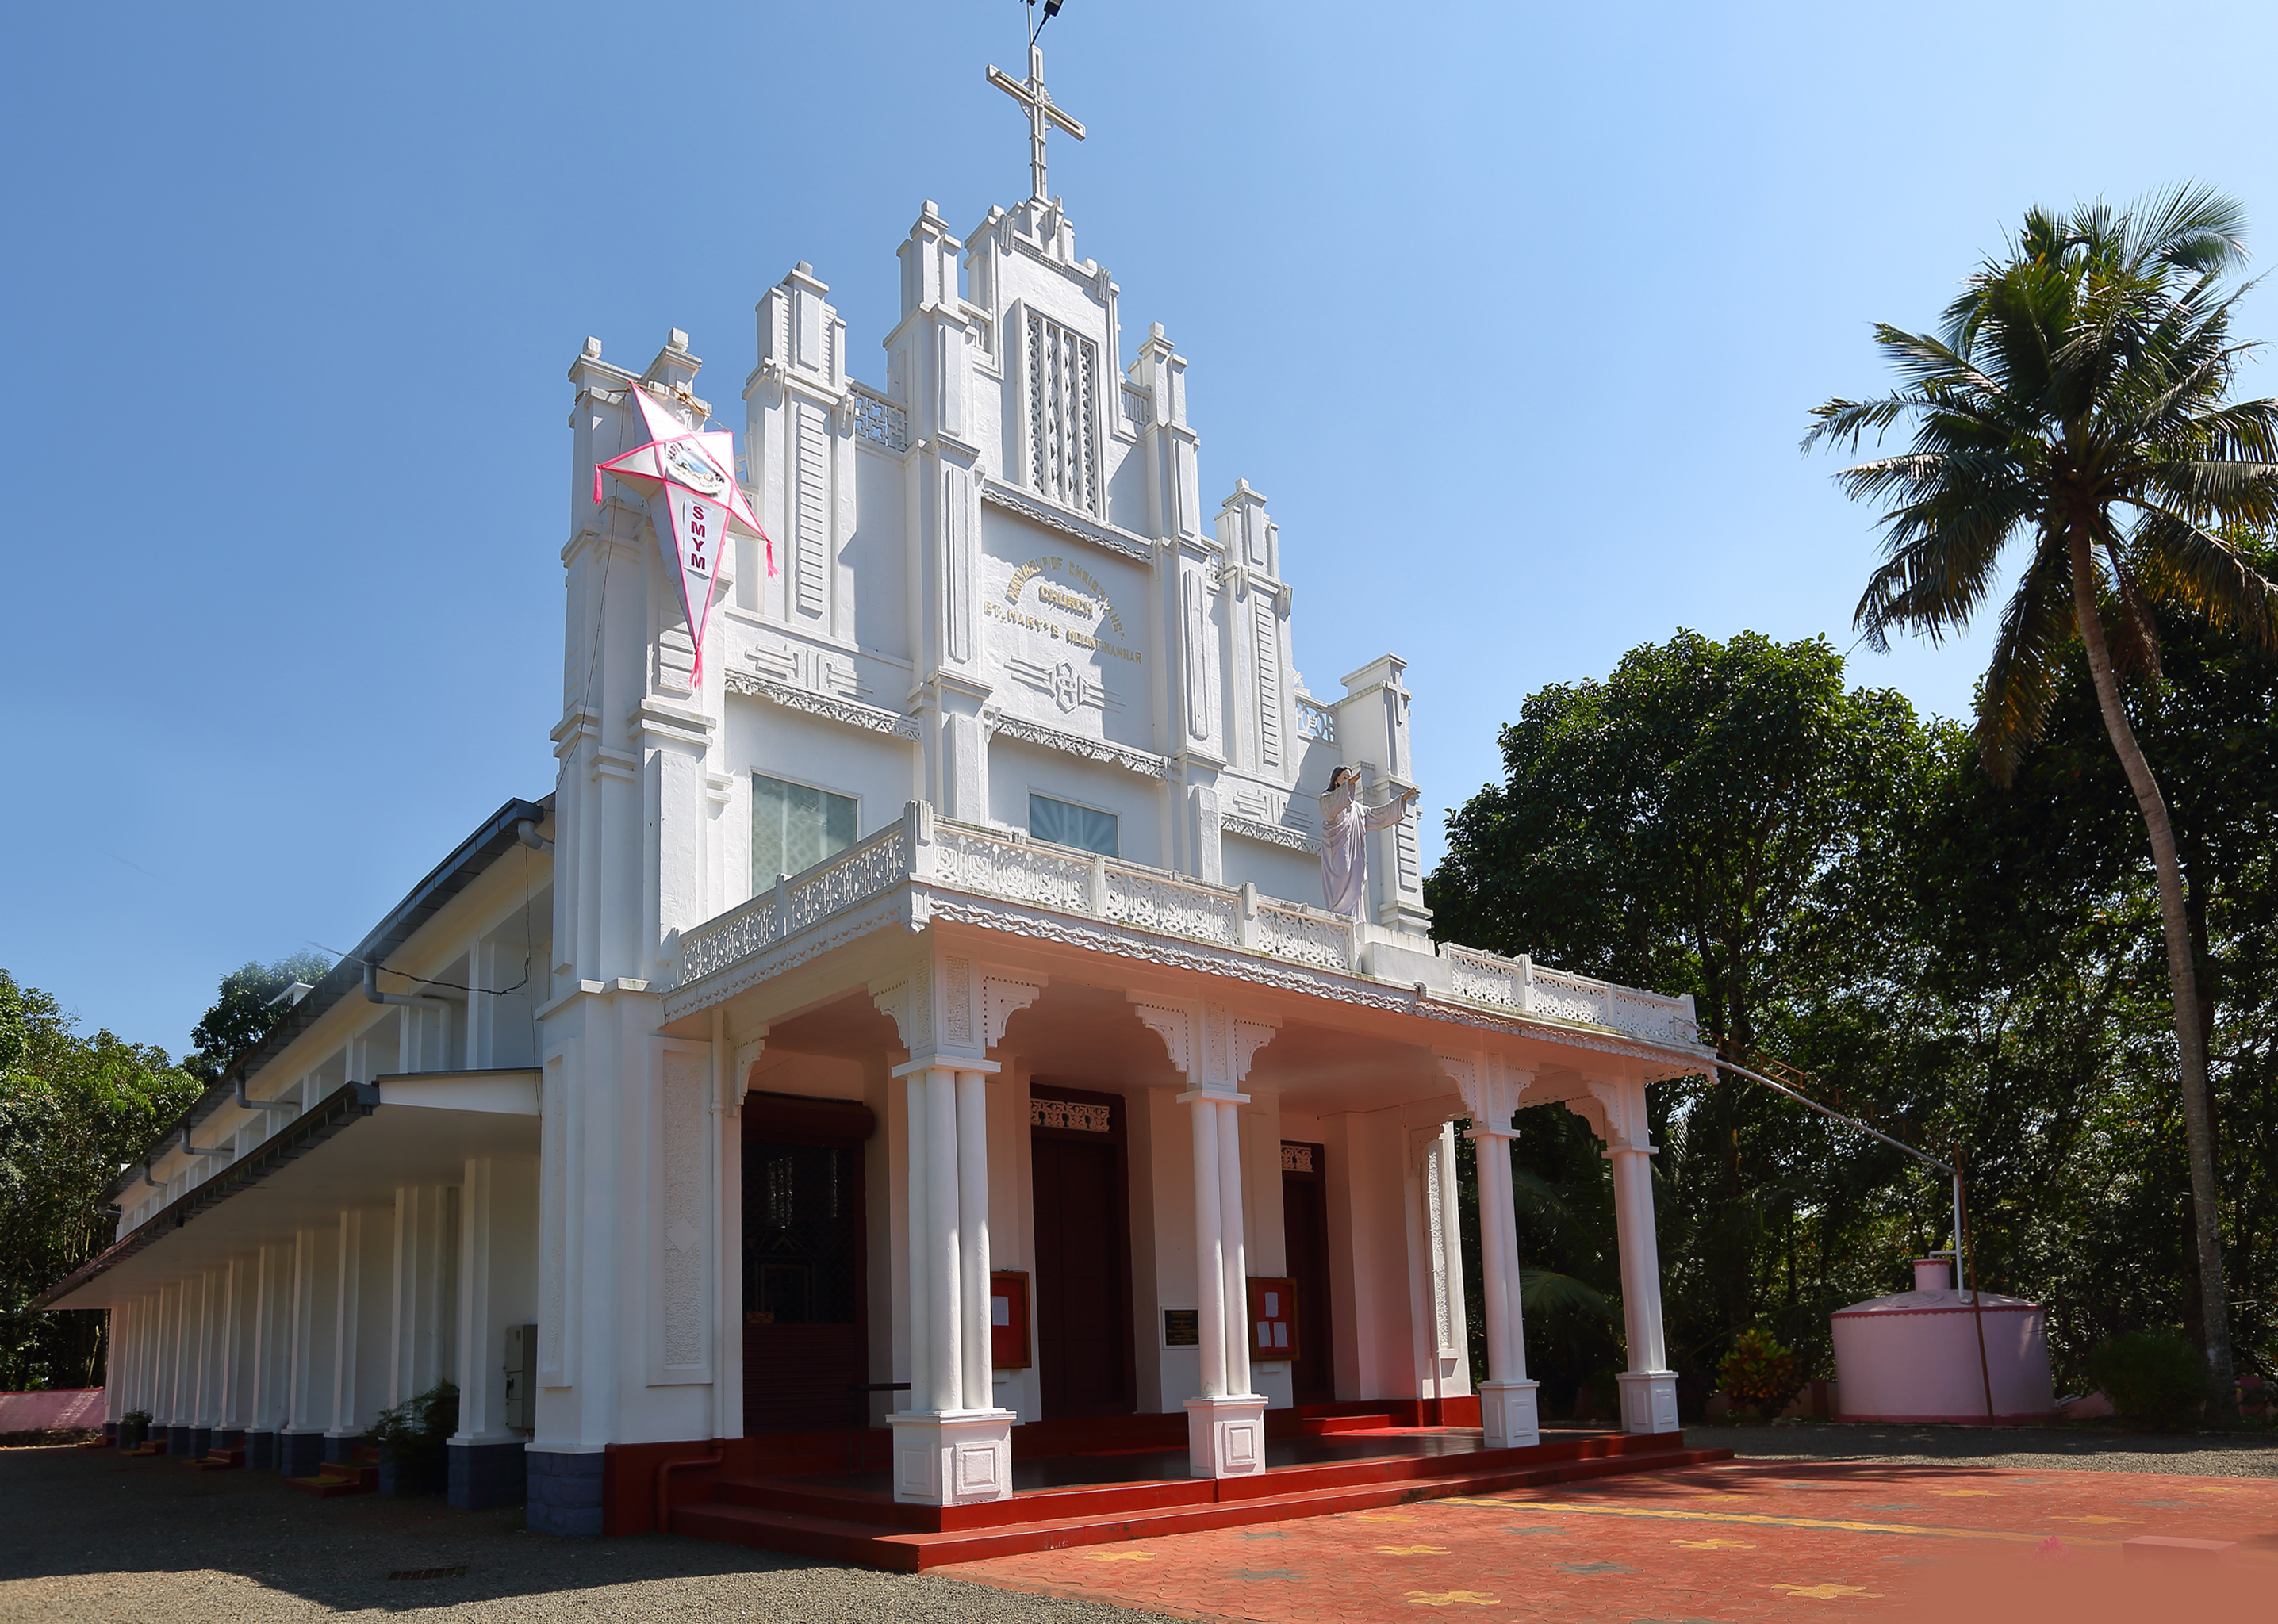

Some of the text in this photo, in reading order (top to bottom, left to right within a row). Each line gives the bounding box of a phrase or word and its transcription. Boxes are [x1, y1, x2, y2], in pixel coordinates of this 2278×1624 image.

[691, 505, 706, 570] SMYM
[1049, 556, 1063, 570] OF
[1041, 585, 1094, 616] CHURCH
